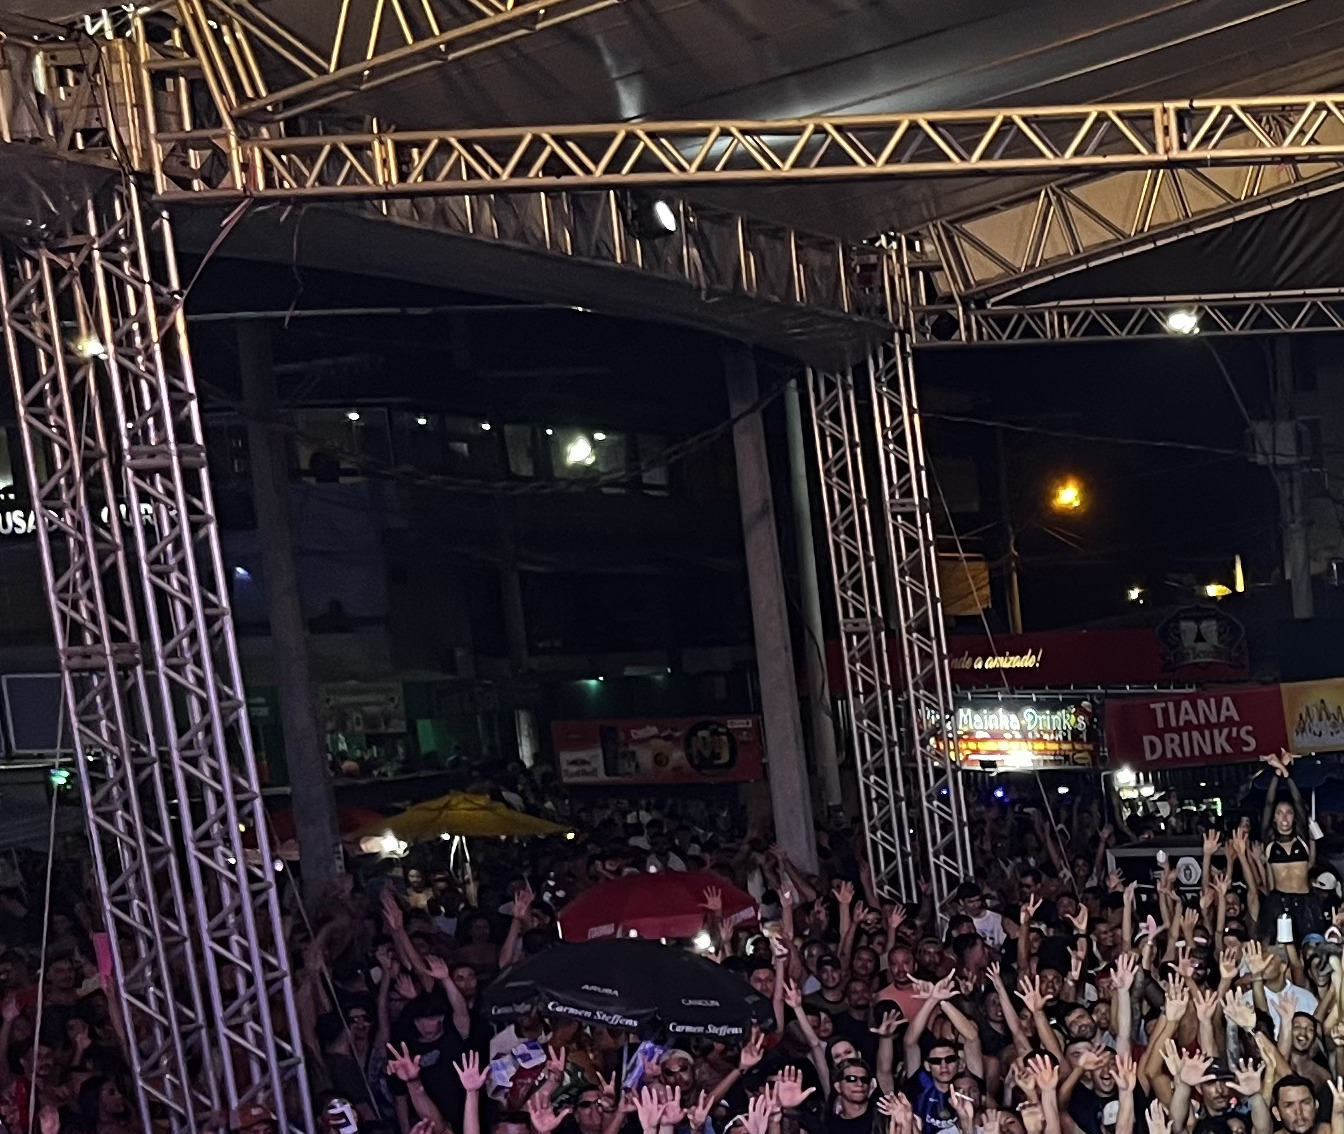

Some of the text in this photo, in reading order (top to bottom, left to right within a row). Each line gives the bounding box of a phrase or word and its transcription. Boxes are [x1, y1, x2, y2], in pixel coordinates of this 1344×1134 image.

[958, 706, 1021, 732] Mainha
[1150, 696, 1240, 729] TIANA
[1142, 725, 1257, 762] DRINK'S
[547, 1000, 593, 1020] Carmen
[593, 1009, 639, 1028] Steffens
[668, 1021, 744, 1036] Carmen Steffens
